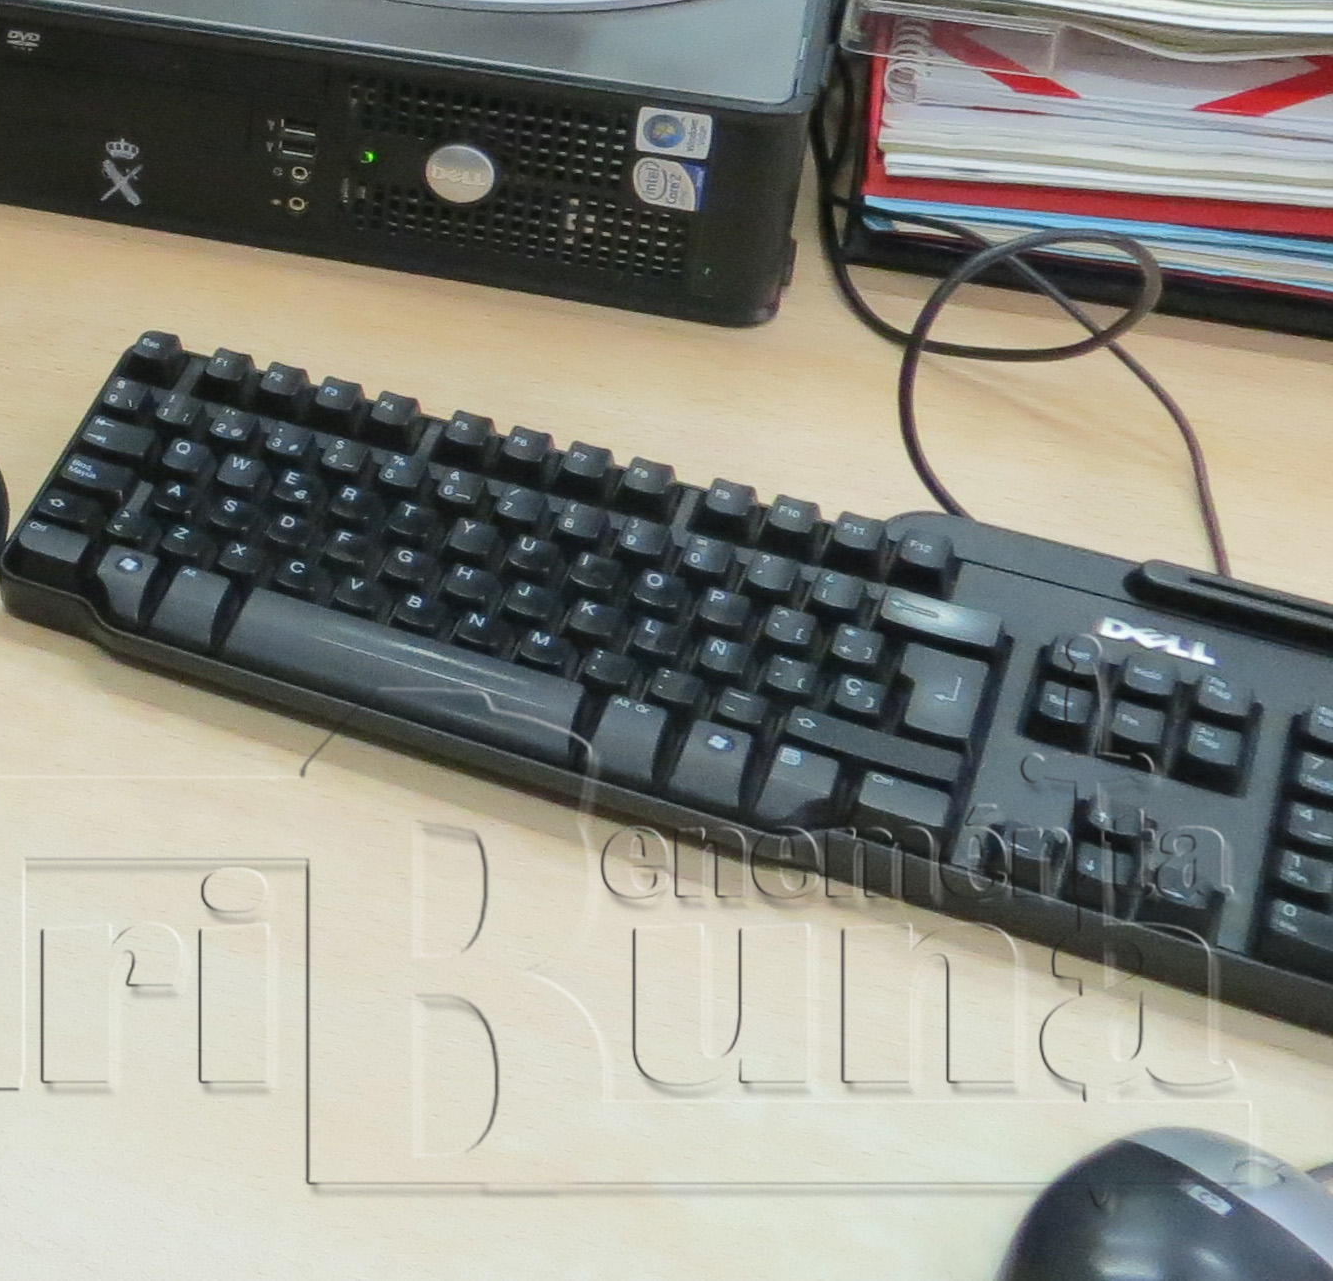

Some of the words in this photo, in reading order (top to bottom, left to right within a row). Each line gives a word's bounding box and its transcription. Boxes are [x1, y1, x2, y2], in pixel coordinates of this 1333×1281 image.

[431, 164, 486, 186] DELL
[142, 338, 161, 351] Esc
[215, 356, 228, 368] F1
[268, 370, 284, 383] F2
[324, 386, 339, 397] F3
[380, 400, 395, 412] F4
[454, 420, 469, 432] F5
[175, 441, 191, 455] Q
[513, 436, 528, 447] F6
[232, 457, 251, 471] W
[572, 451, 588, 463] F7
[284, 471, 298, 485] E
[633, 467, 649, 479] F8
[341, 487, 357, 502] R
[714, 488, 731, 500] F9
[401, 504, 417, 517] T
[778, 505, 801, 519] F10
[463, 520, 477, 534] Y
[842, 522, 866, 536] F11
[520, 538, 536, 553] U
[909, 539, 933, 555] F12
[581, 554, 591, 567] I
[646, 573, 664, 589] O
[709, 589, 727, 603] P
[1098, 617, 1217, 666] DELL
